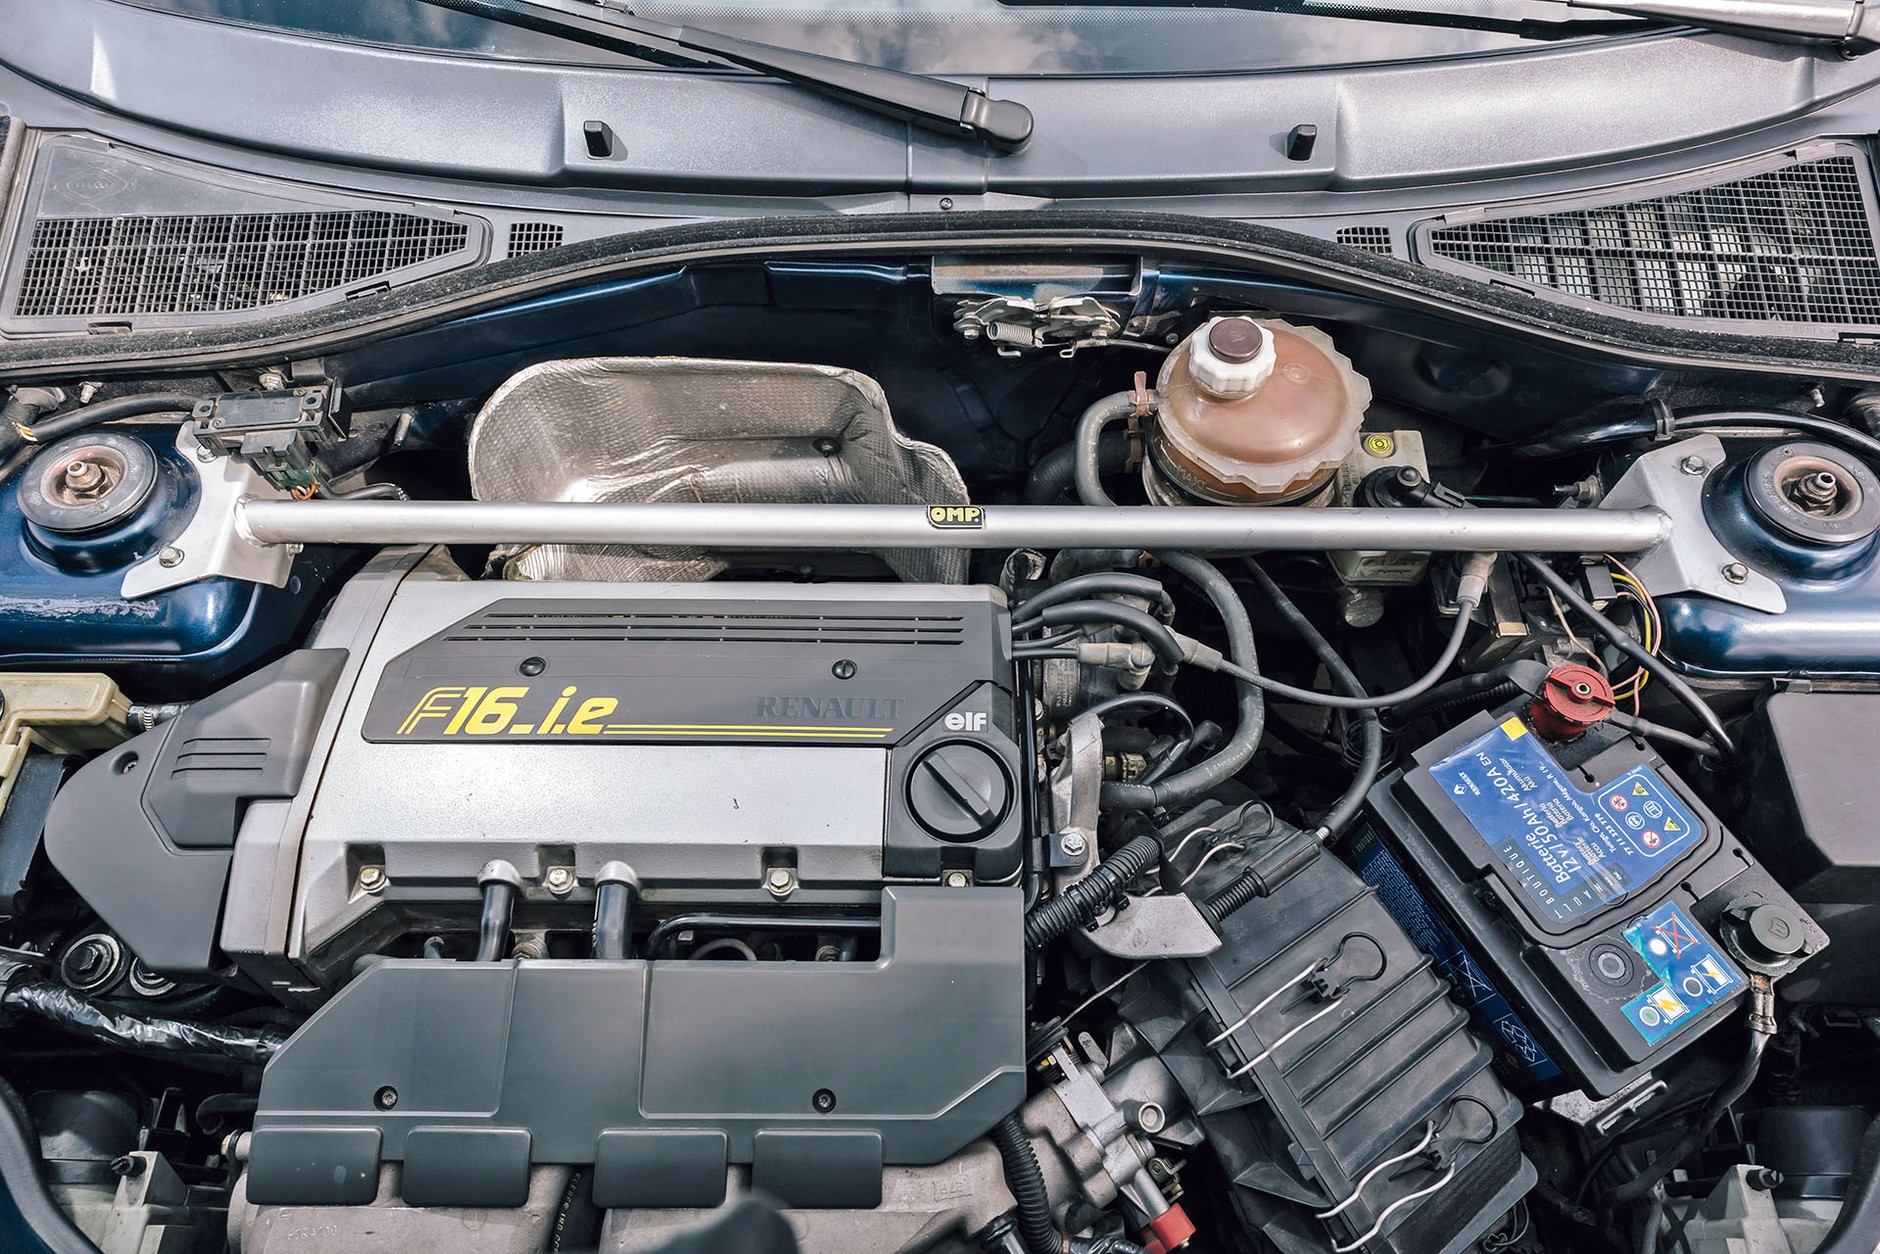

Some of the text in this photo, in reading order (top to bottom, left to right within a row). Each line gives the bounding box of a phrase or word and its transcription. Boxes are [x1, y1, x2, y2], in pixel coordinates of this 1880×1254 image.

[930, 507, 980, 522] OMP
[756, 695, 904, 720] RENAULT
[944, 711, 988, 731] elf
[1475, 751, 1492, 766] EN
[1458, 771, 1481, 796] RENAULT
[1522, 775, 1538, 788] Akü
[1538, 802, 1562, 828] Batteria
[1594, 812, 1634, 855] 77 11 222 779
[1524, 831, 1571, 883] Batterie
[1573, 840, 1595, 866] Battery
[1590, 841, 1606, 858] Accu
[1502, 845, 1555, 905] BOUTIQUE
